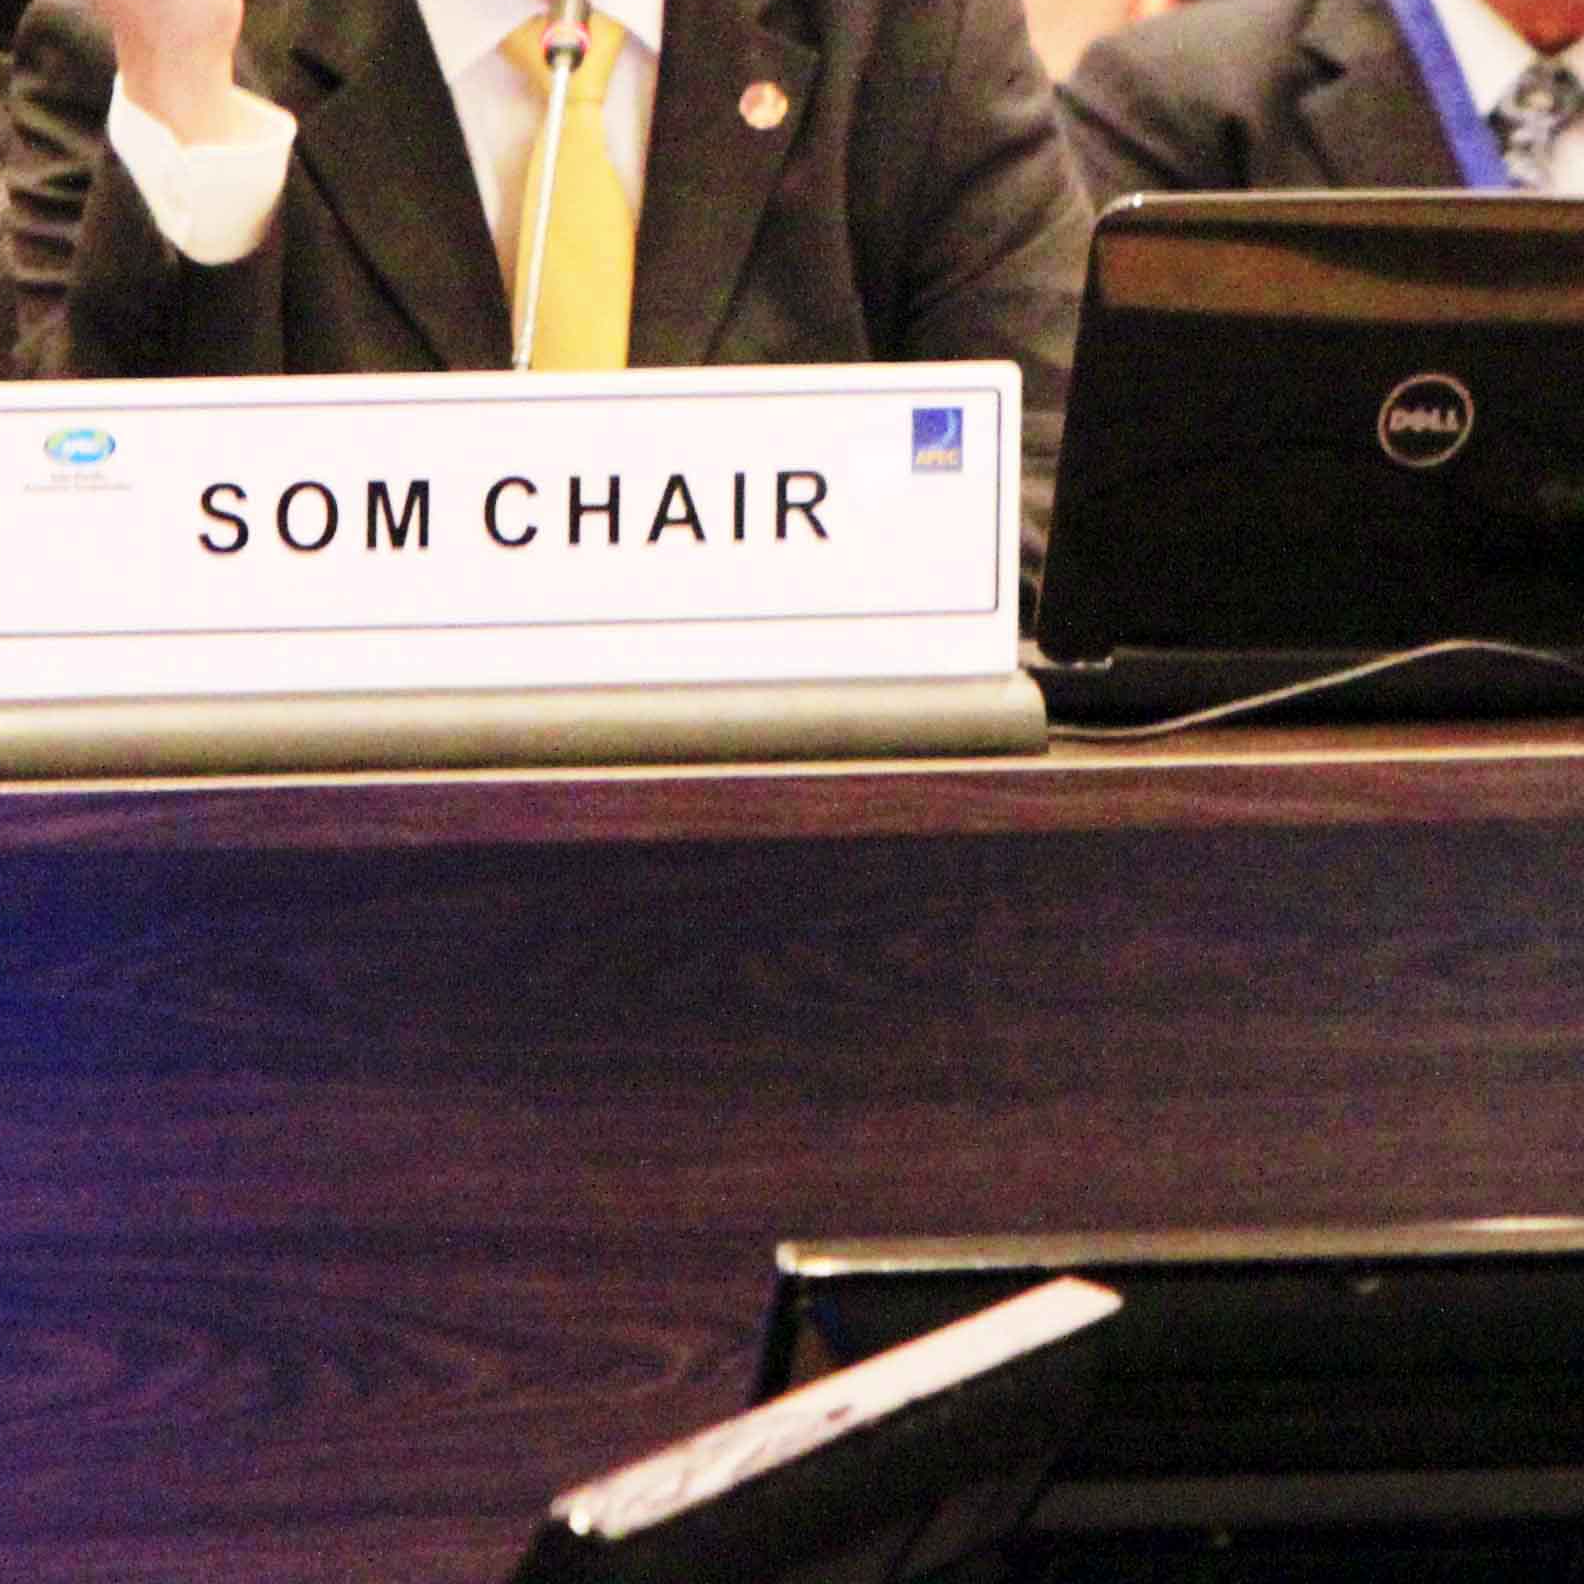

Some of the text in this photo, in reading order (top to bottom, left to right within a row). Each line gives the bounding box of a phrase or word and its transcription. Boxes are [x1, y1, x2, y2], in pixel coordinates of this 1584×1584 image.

[1389, 406, 1459, 433] DELL
[198, 470, 830, 554] SOM CHAIR
